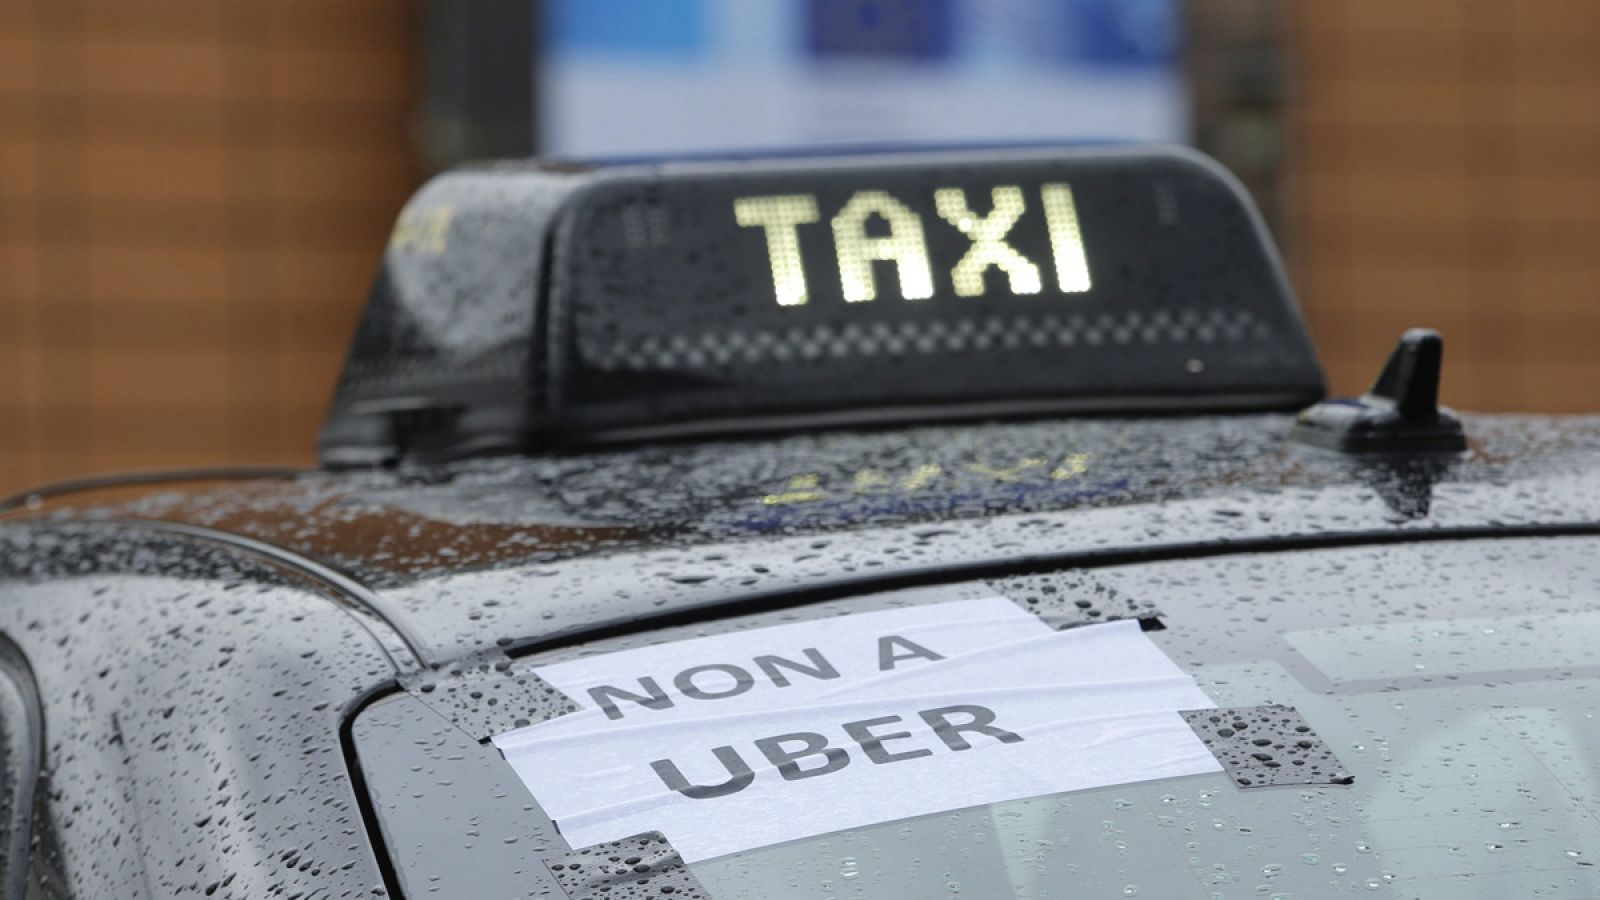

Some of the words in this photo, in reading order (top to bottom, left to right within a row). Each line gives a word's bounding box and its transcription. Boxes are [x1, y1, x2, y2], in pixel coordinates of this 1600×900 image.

[733, 183, 1093, 306] TAXI
[587, 647, 841, 720] NON
[877, 635, 946, 671] A
[650, 704, 1025, 799] UBER
